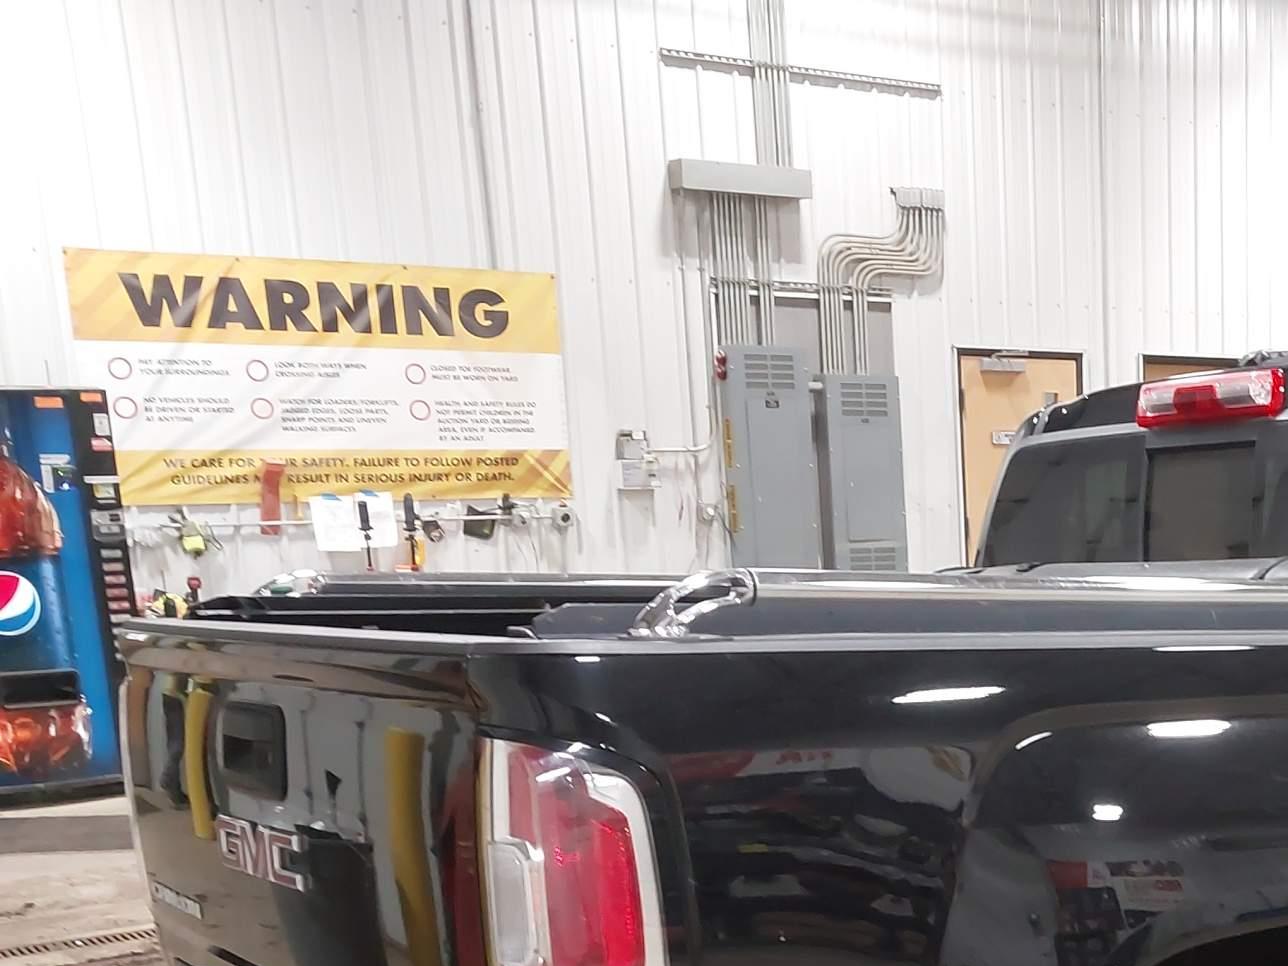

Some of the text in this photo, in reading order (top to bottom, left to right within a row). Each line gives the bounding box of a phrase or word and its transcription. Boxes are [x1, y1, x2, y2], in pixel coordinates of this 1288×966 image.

[118, 273, 509, 339] WARNING
[164, 458, 186, 469] WE
[191, 458, 224, 468] CARE
[228, 458, 256, 468] FOR
[353, 456, 400, 467] FAILURE
[404, 457, 420, 467] TO
[424, 457, 473, 467] FOLLOW
[476, 457, 519, 466] POSTED
[170, 473, 250, 486] GUIDELINES
[287, 472, 332, 484] RESULT
[335, 472, 350, 484] IN
[354, 472, 404, 484] SERIOUS
[408, 472, 452, 482] INJURY
[455, 472, 473, 482] OR
[216, 814, 307, 892] GMC
